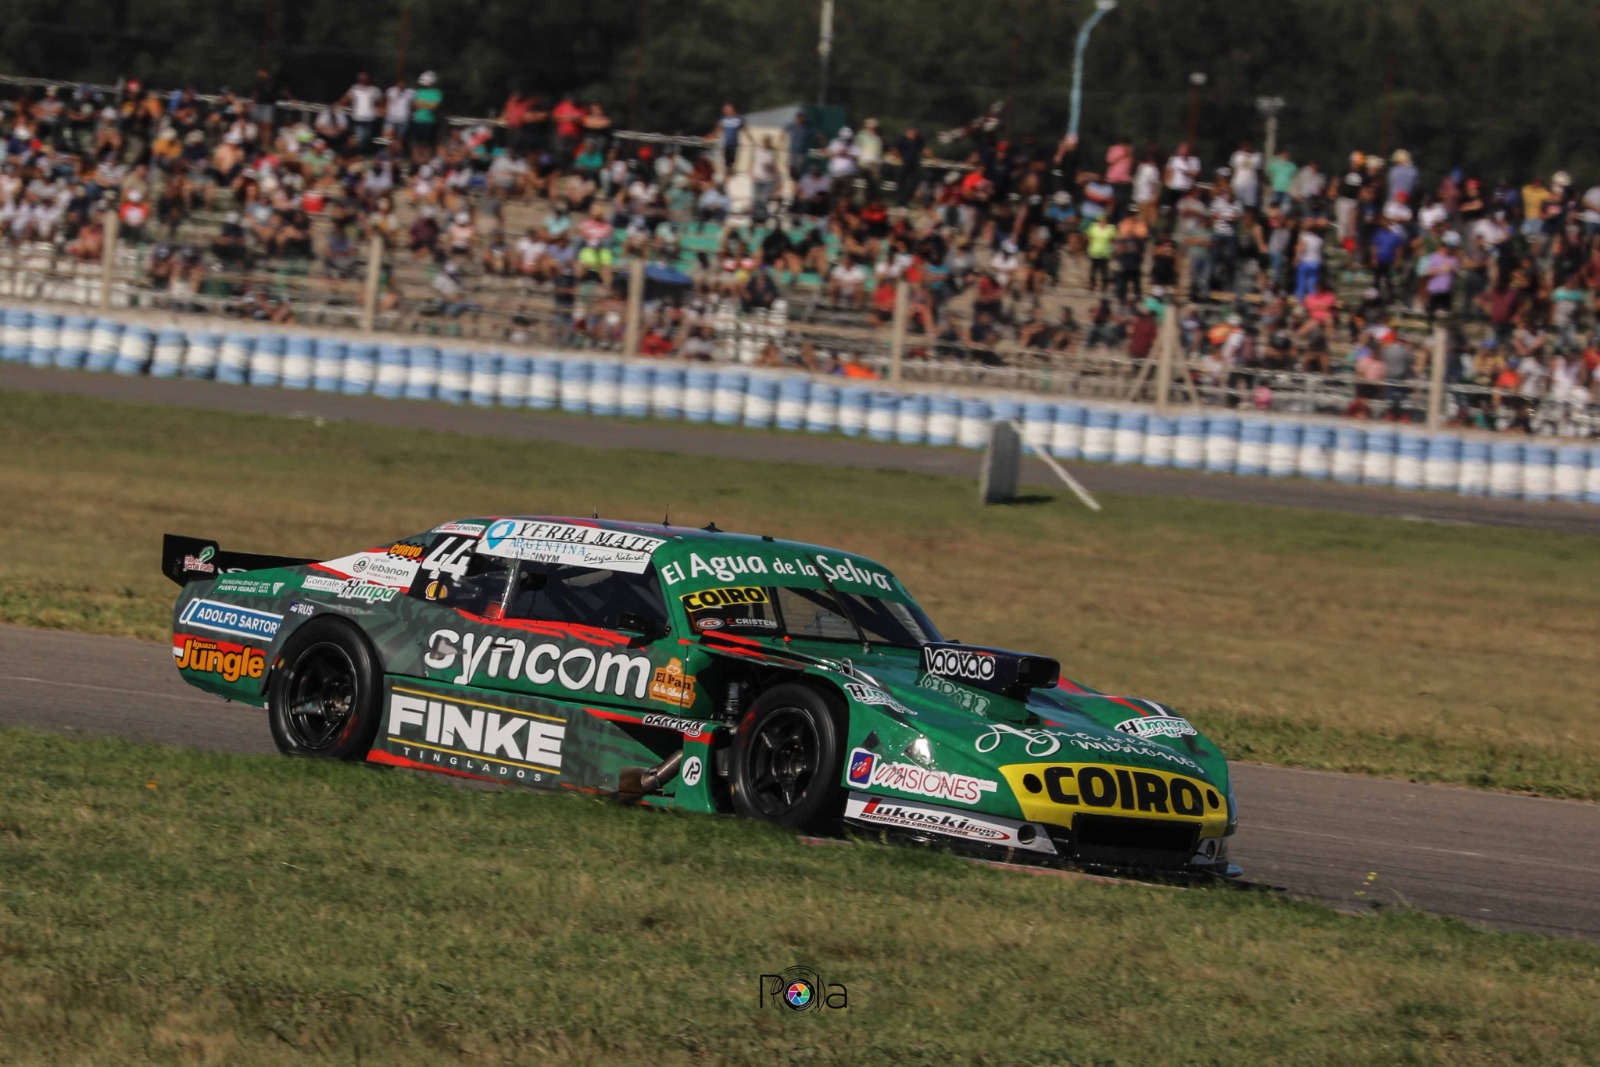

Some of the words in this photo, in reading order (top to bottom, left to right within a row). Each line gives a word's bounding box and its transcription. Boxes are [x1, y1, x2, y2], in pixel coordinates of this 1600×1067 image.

[510, 537, 586, 557] ARGENTINA
[516, 522, 589, 543] YERBA
[591, 531, 660, 554] MATE
[389, 544, 423, 558] CURVO
[421, 536, 478, 585] 44
[369, 563, 410, 577] lebanon
[661, 561, 686, 586] El
[689, 552, 769, 582] Agua
[772, 557, 797, 576] de
[795, 558, 819, 577] la
[816, 554, 893, 592] Selva
[217, 584, 237, 592] PUERTO
[305, 576, 344, 588] Gonzalez
[340, 577, 399, 603] Himpa
[682, 587, 766, 610] COIRO
[197, 607, 238, 626] ADOLFO
[297, 603, 314, 616] RUS
[192, 637, 217, 650] Iguazu
[176, 639, 265, 682] Jungle
[655, 672, 666, 683] El
[667, 674, 691, 690] Pan
[387, 693, 567, 769] FINKE
[403, 746, 543, 783] TINGLADOS
[1043, 766, 1204, 818] COIRO
[859, 812, 898, 824] Materiales
